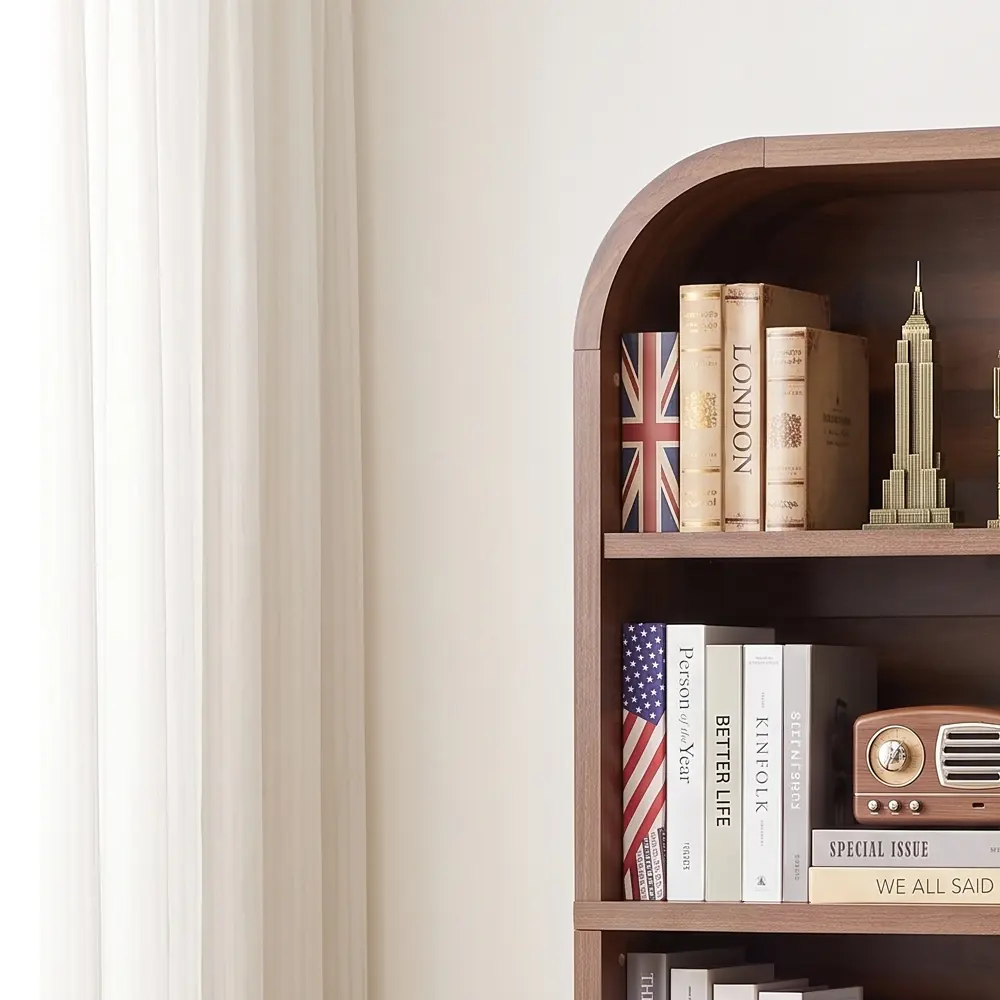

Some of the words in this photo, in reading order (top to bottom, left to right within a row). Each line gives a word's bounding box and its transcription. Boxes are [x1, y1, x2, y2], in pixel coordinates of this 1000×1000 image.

[732, 343, 752, 475] LONDON
[678, 647, 694, 710] Person
[678, 713, 689, 727] of
[680, 727, 690, 744] the
[679, 742, 695, 784] Year
[715, 715, 731, 784] BETTER
[755, 717, 769, 813] KINFOLK
[716, 789, 731, 827] LIFE
[829, 840, 885, 858] SPECIAL
[891, 840, 929, 858] ISSUE
[875, 878, 906, 895] WE
[911, 878, 946, 895] ALL
[951, 877, 994, 895] SAID
